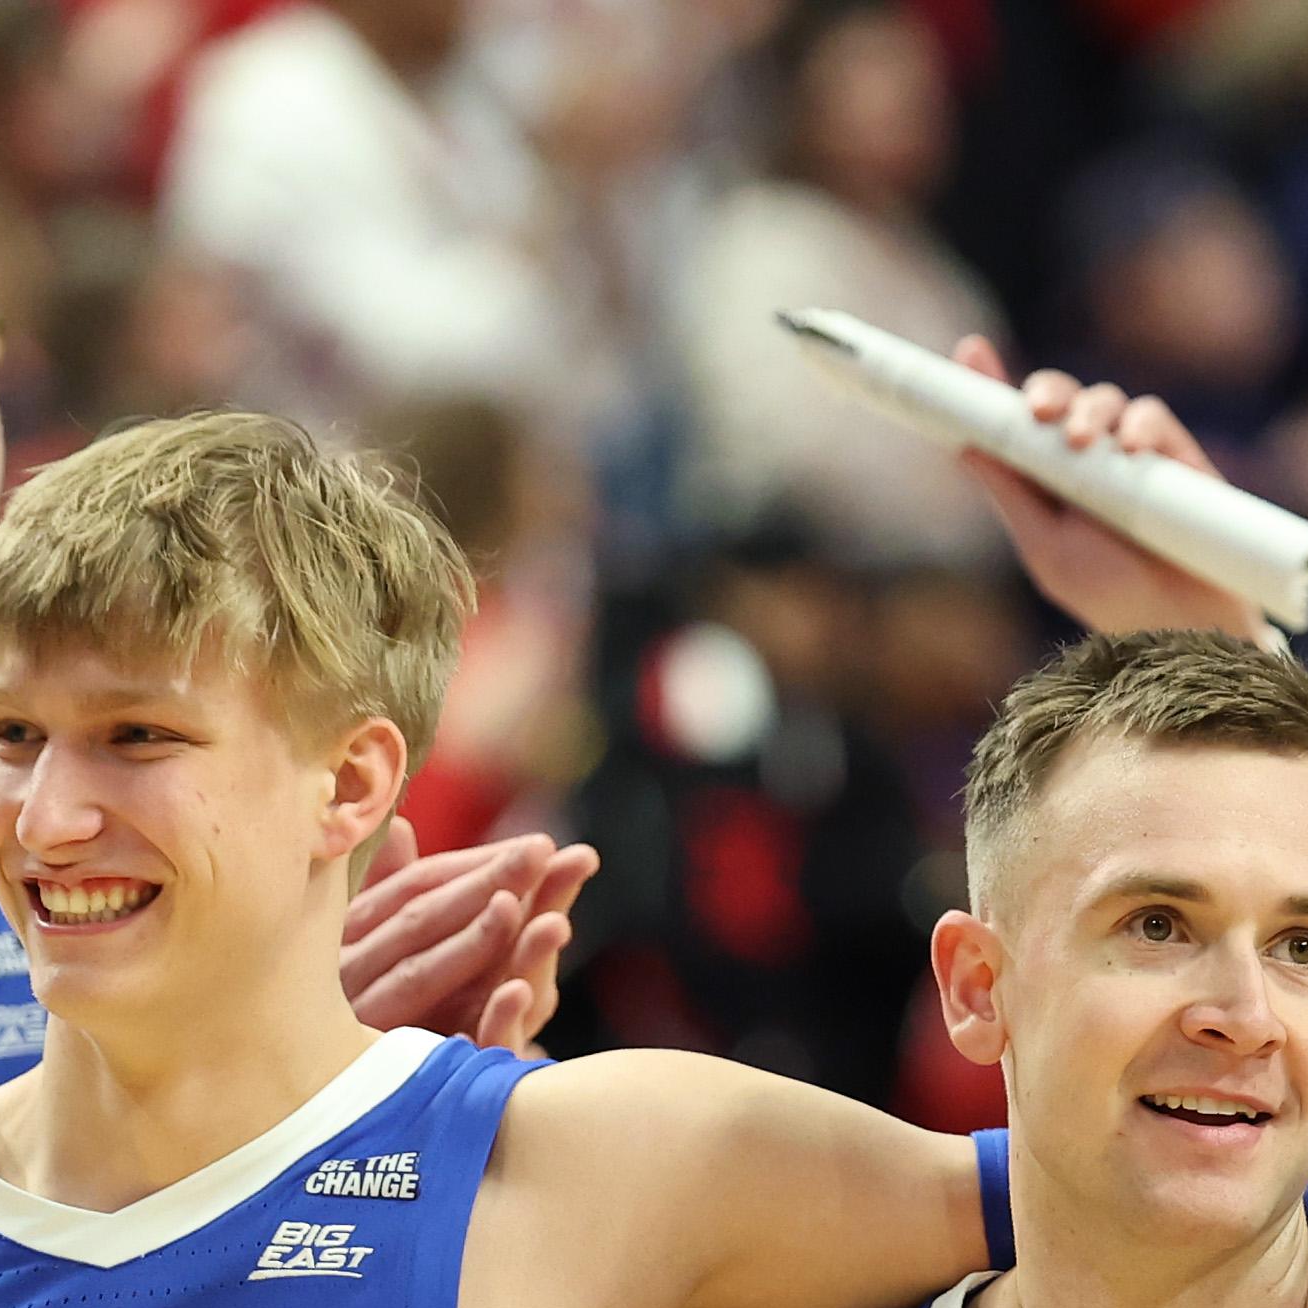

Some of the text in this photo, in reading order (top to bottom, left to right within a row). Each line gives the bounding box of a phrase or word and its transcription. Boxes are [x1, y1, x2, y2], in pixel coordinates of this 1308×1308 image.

[319, 1152, 418, 1173] BE THE
[305, 1171, 420, 1199] CHANGE
[271, 1221, 357, 1247] BIG
[257, 1245, 374, 1269] EAST
